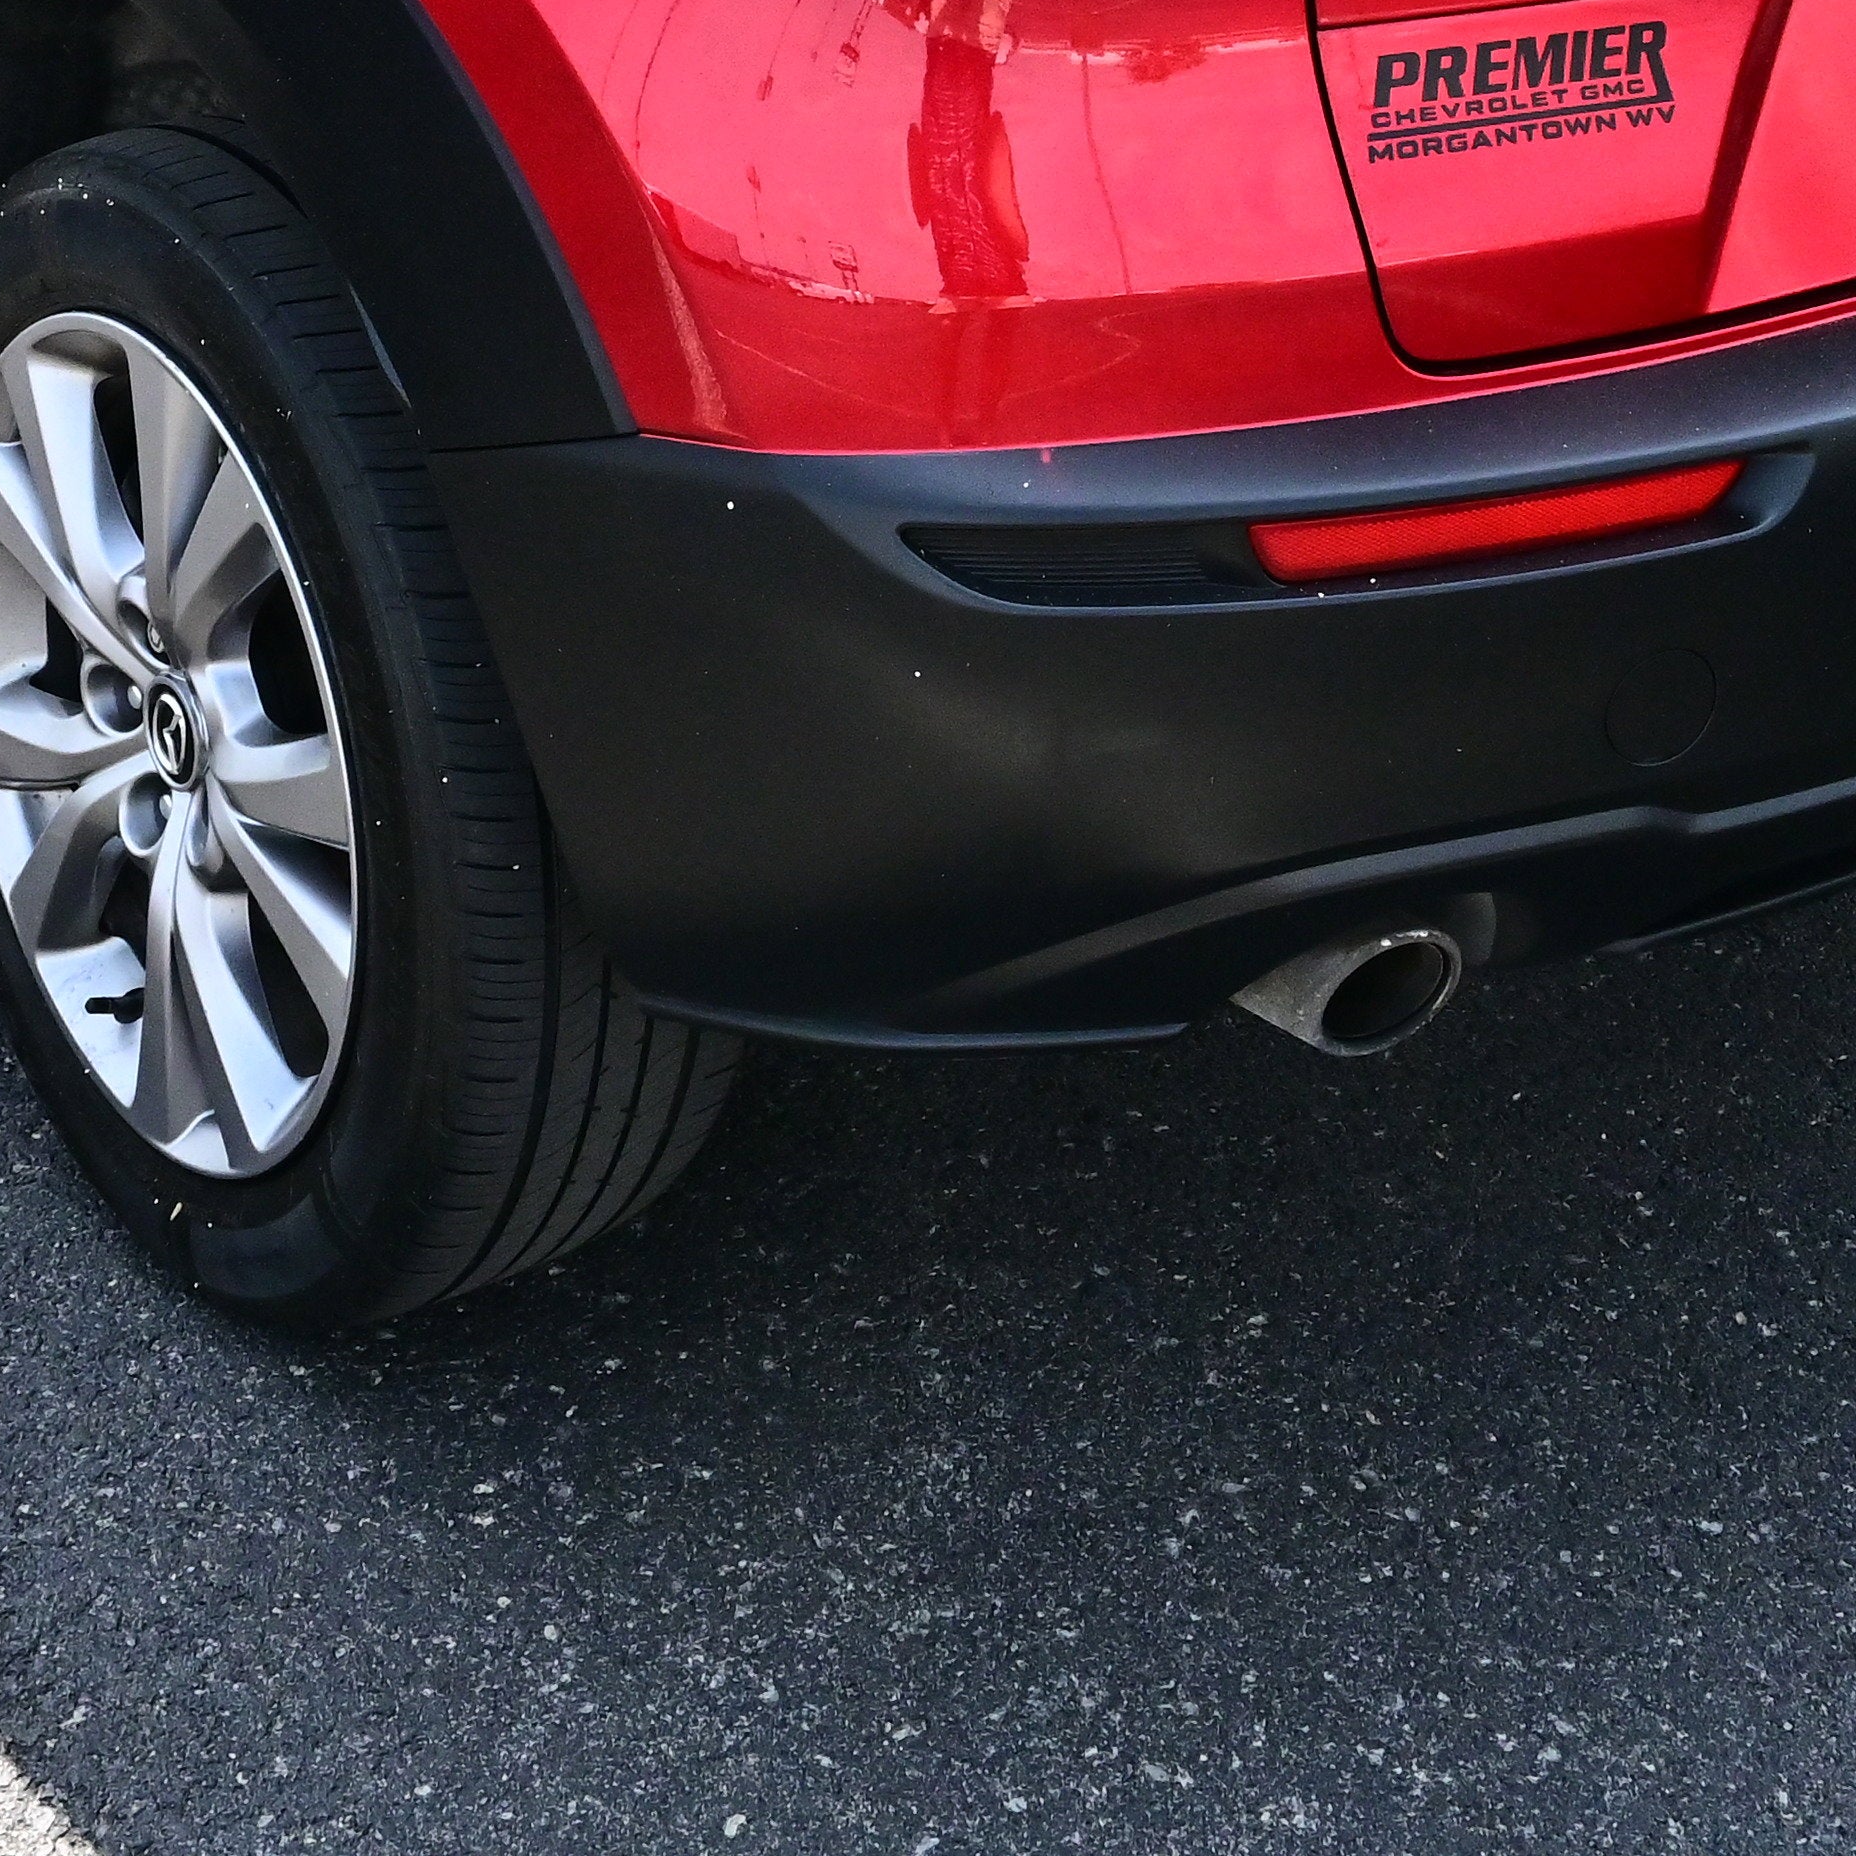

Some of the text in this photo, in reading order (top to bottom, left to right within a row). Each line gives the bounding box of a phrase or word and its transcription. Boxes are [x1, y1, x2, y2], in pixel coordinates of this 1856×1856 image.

[1373, 20, 1675, 108] PREMIER
[1371, 78, 1645, 128] CHEVROLET GMC
[1367, 105, 1675, 164] MORGANTOWN WV
